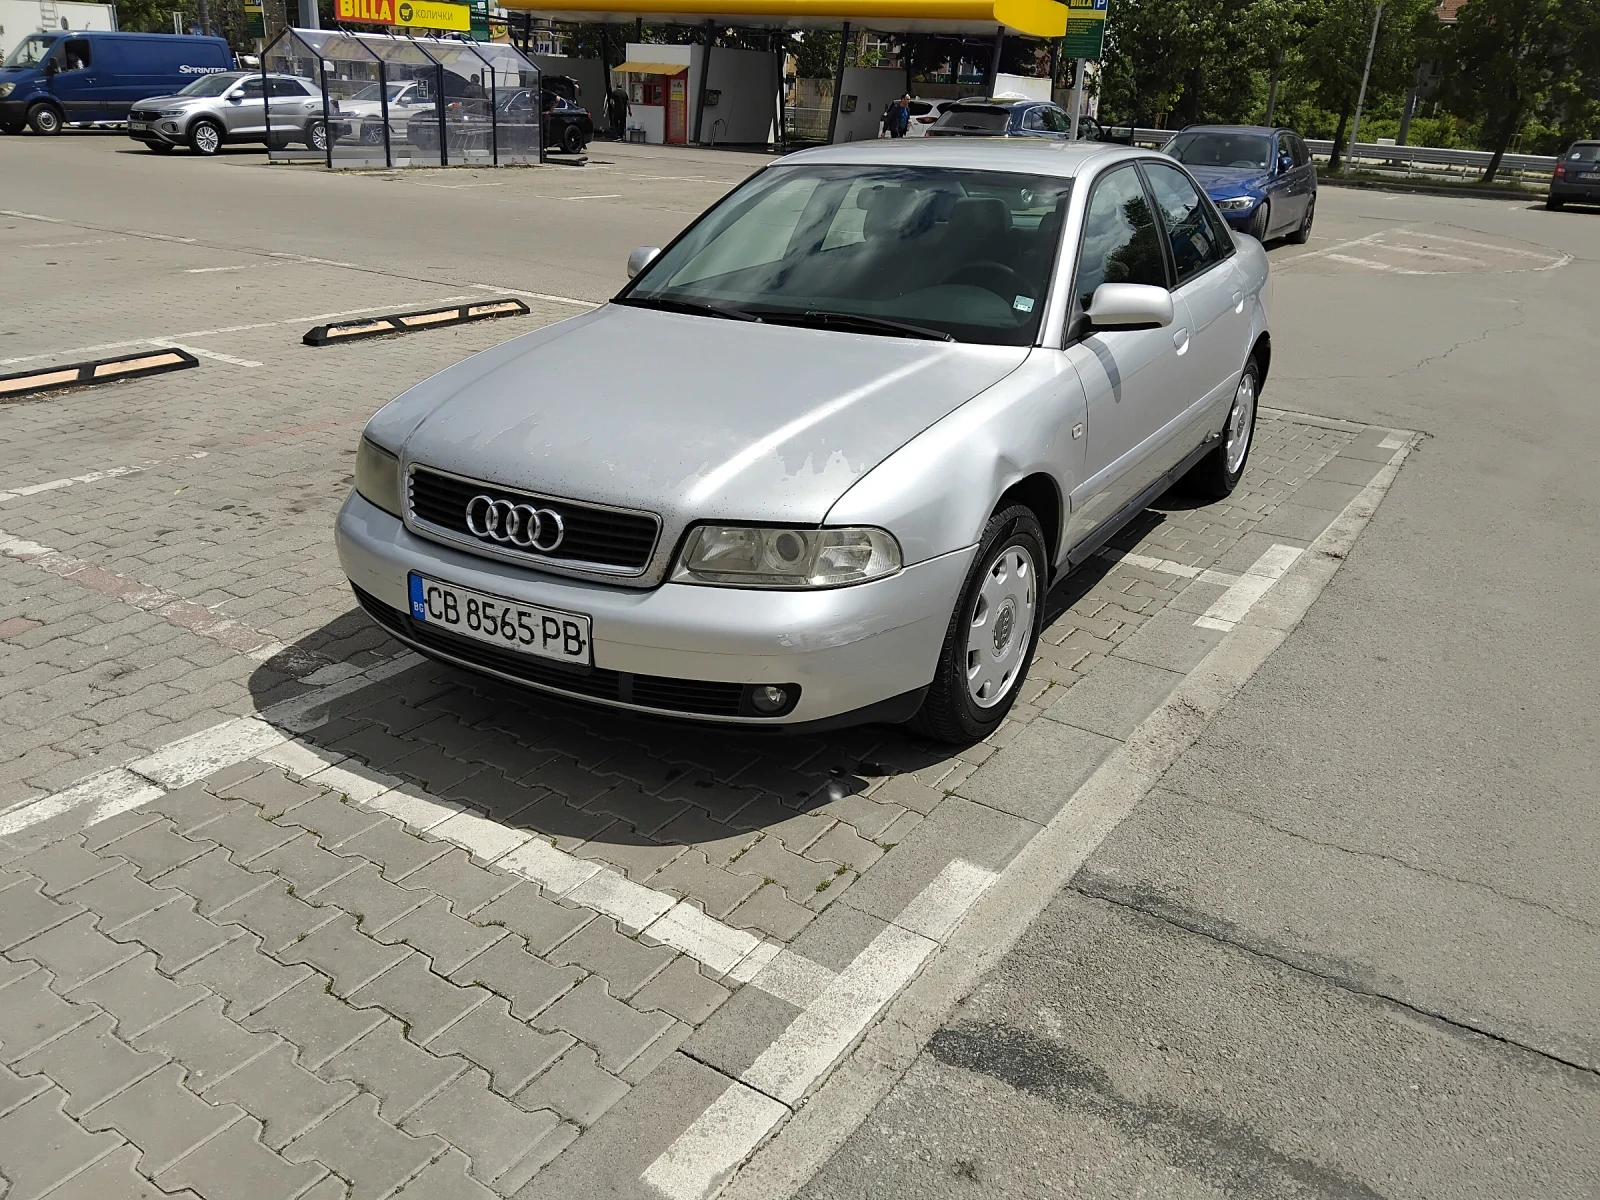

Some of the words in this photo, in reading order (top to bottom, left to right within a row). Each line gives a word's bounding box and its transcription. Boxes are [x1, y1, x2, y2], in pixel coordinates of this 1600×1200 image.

[340, 0, 392, 21] BILLA
[415, 9, 454, 21] КОЛИЧКИ
[413, 601, 424, 613] BG
[426, 586, 460, 625] CB
[466, 597, 535, 646] 8565
[541, 614, 583, 656] PB
